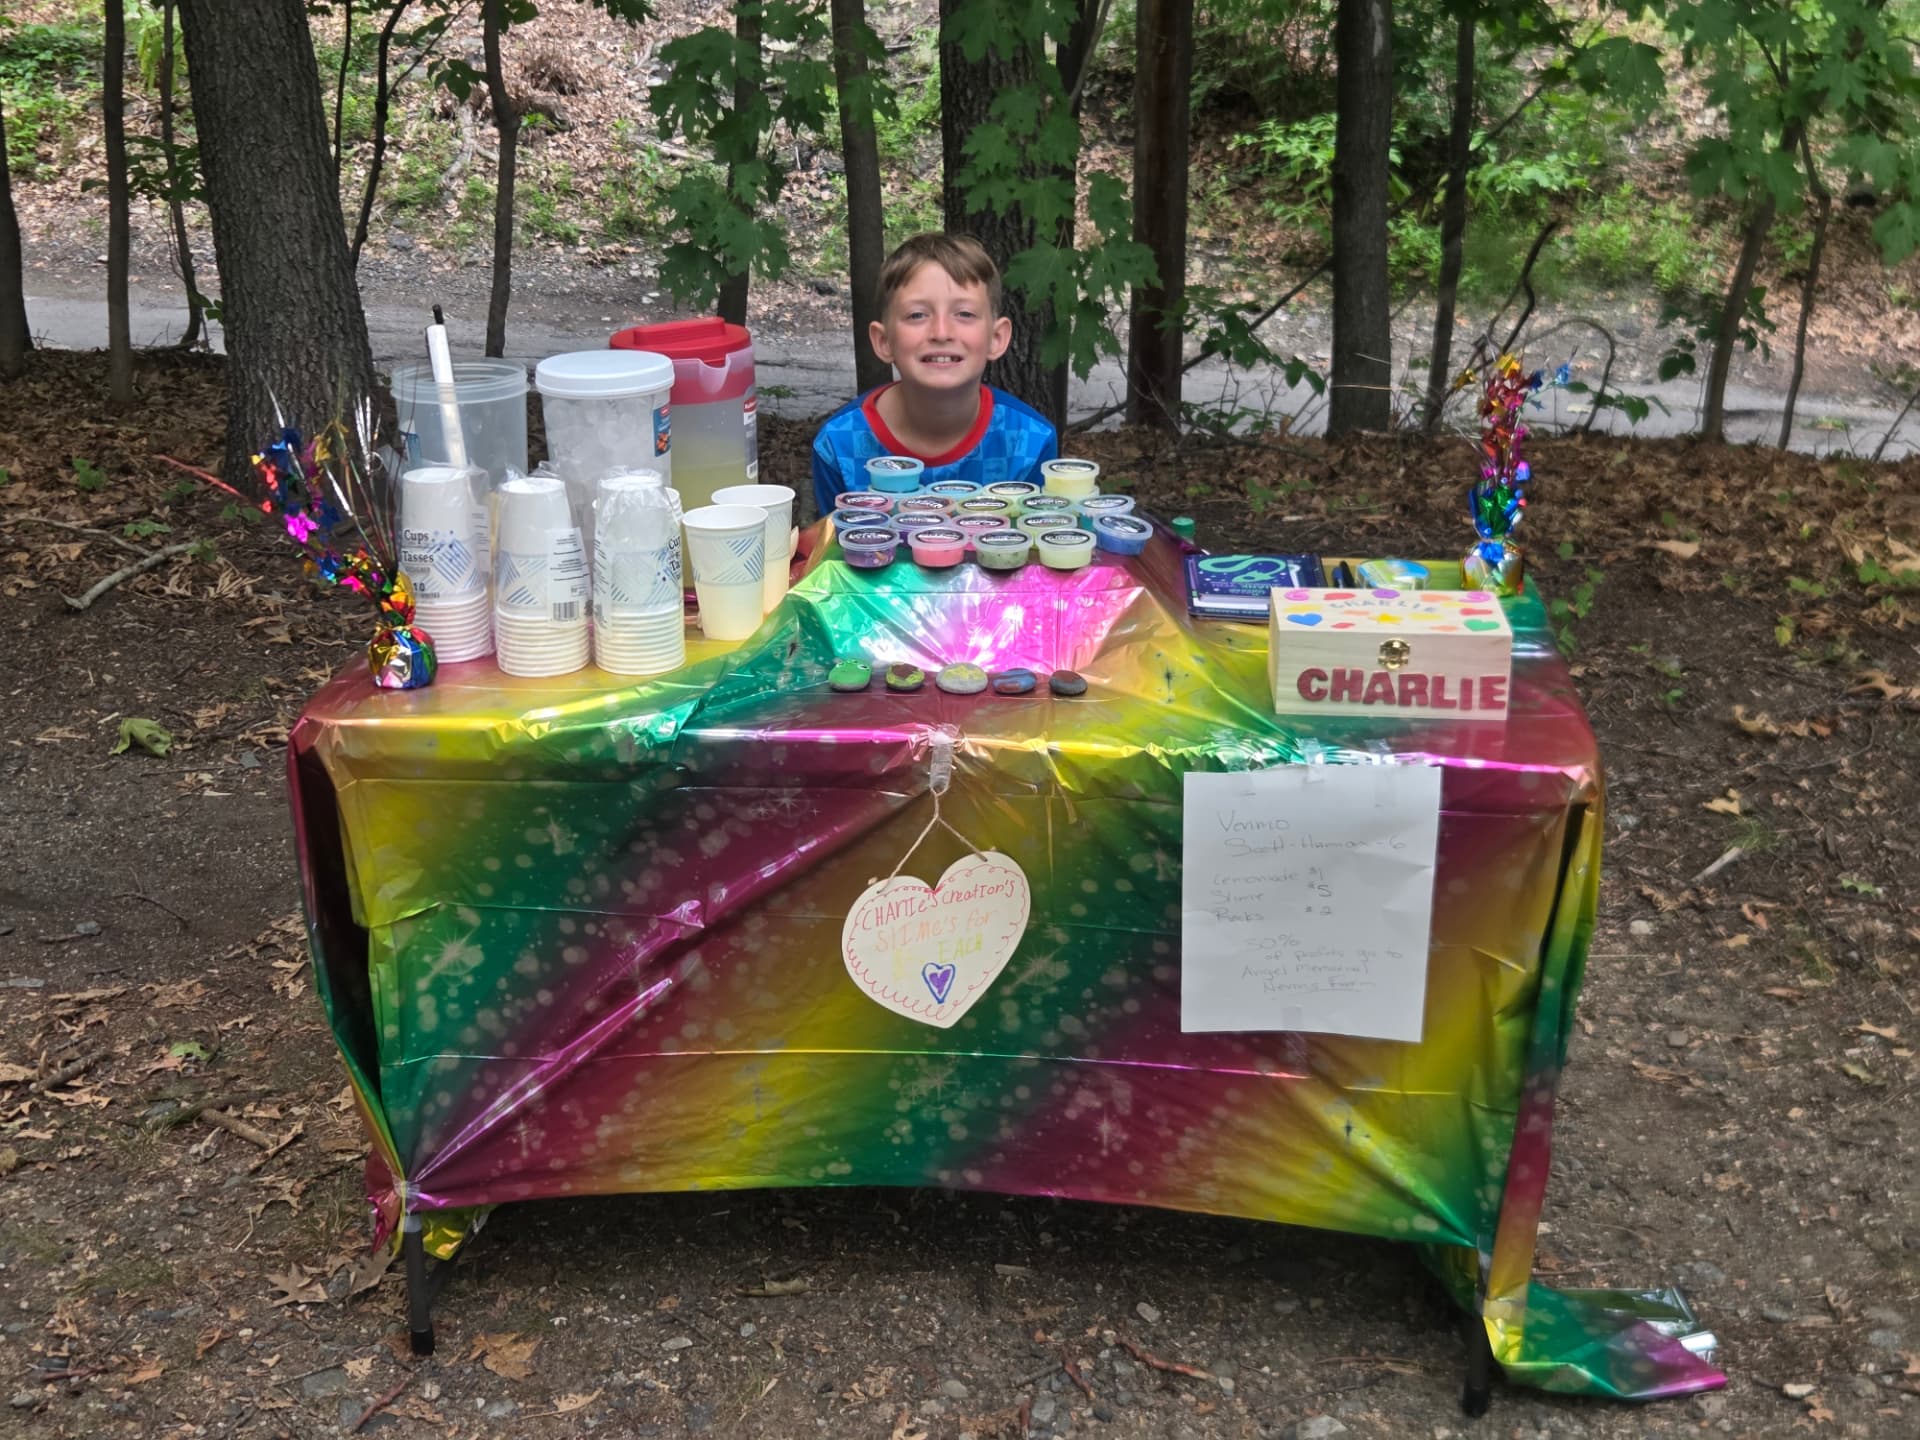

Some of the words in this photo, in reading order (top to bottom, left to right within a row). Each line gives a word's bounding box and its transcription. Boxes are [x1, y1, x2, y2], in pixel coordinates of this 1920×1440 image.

[404, 530, 429, 545] Cups
[403, 551, 434, 563] Tasses
[1296, 667, 1508, 711] CHARLIE
[1217, 810, 1290, 832] Venmo
